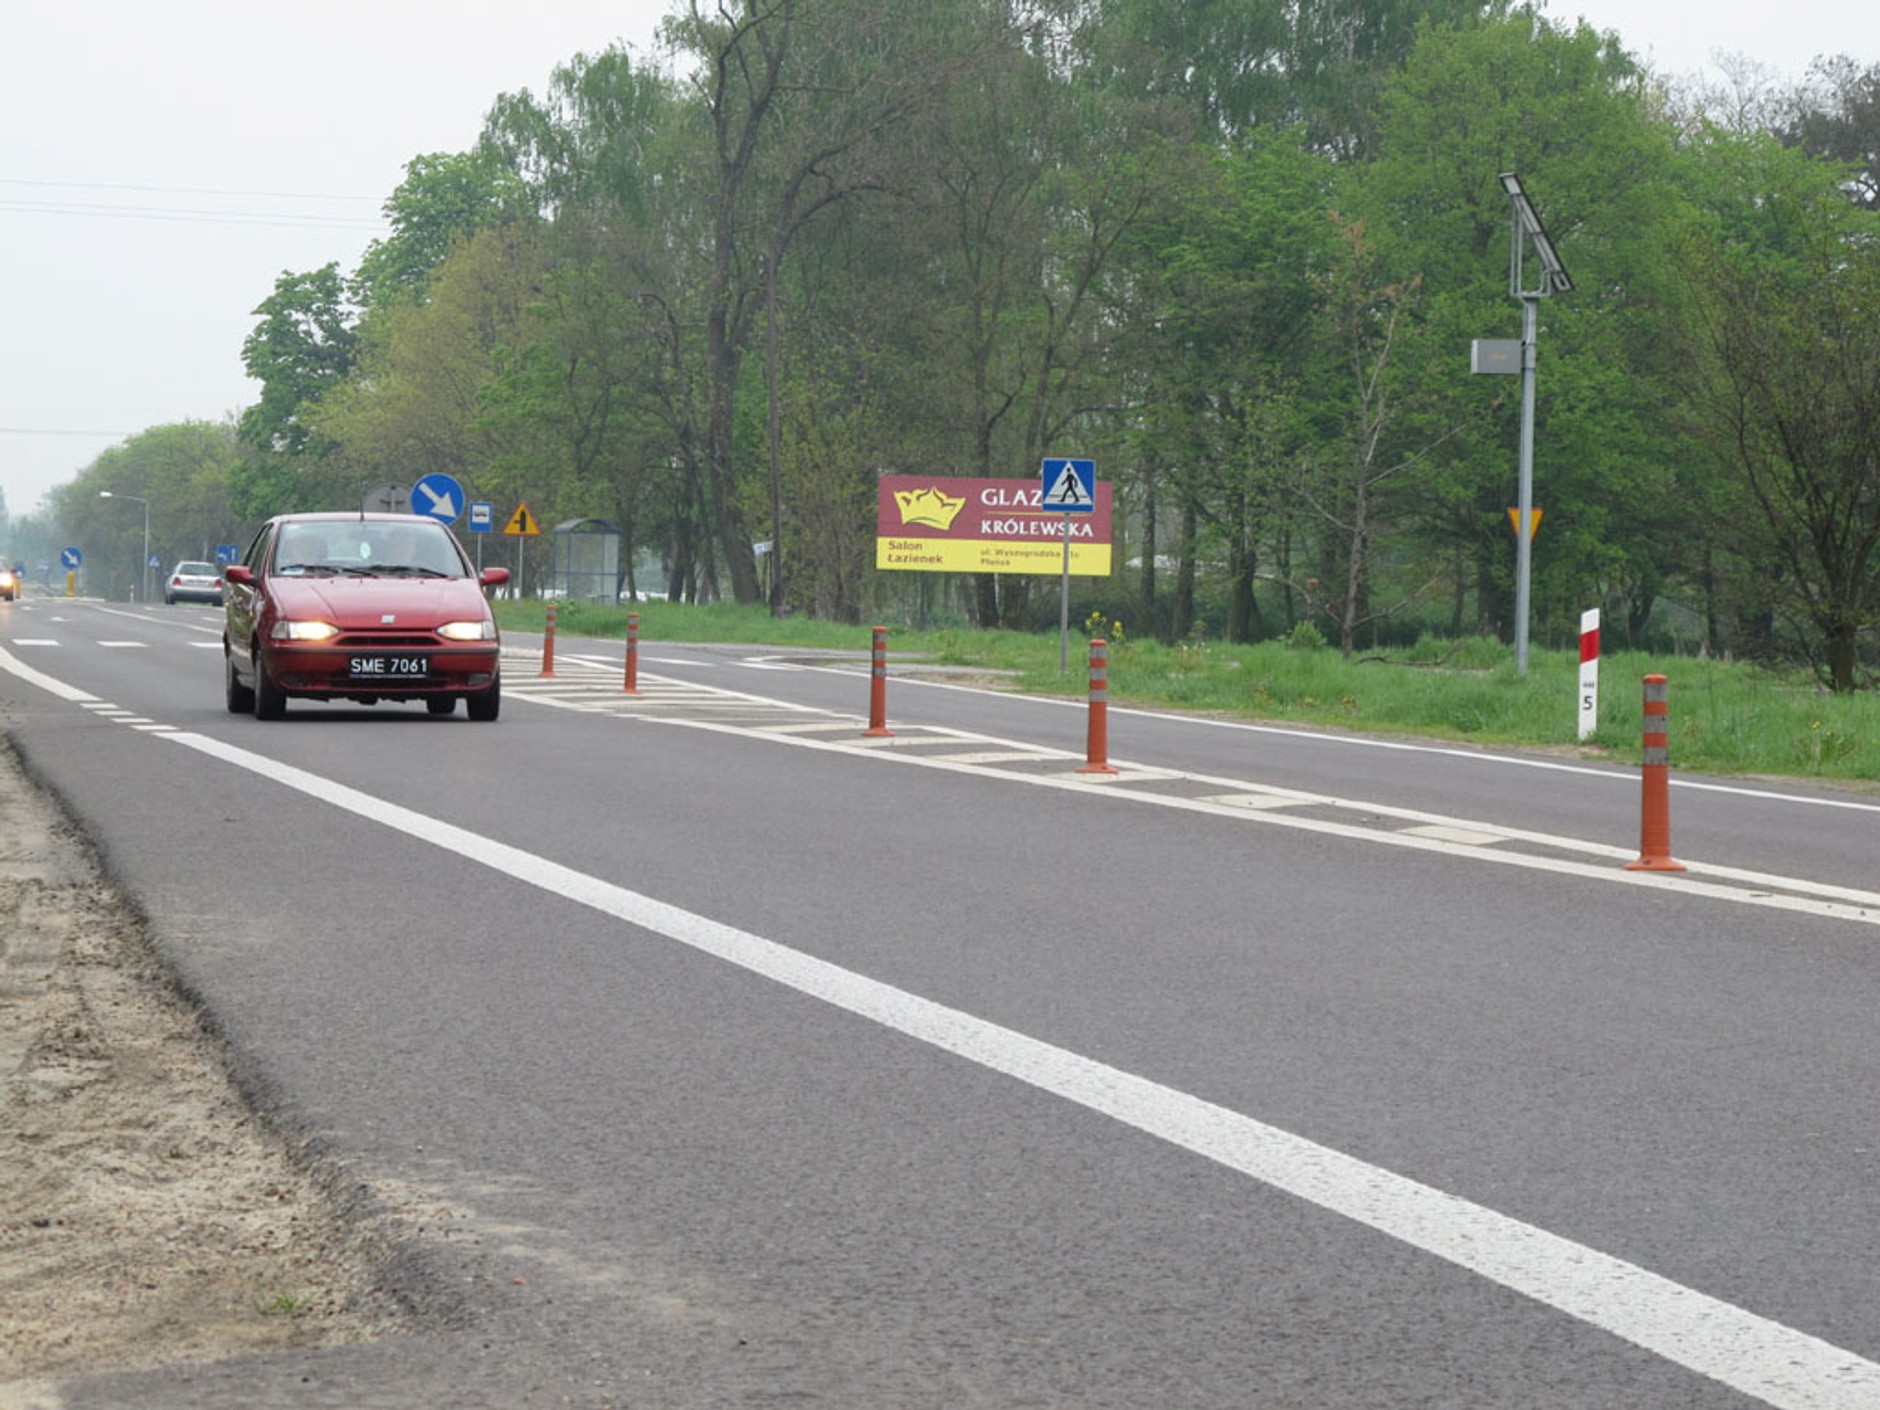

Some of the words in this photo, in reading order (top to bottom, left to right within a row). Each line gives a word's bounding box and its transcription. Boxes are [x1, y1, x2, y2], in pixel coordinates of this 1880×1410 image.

[981, 488, 1044, 507] GLAZ
[981, 518, 1094, 537] KRÓLEWSKA
[888, 540, 923, 551] Salon
[887, 553, 943, 564] Łazienek
[351, 658, 385, 673] SME
[390, 658, 428, 673] 7061
[1583, 695, 1593, 710] 5
